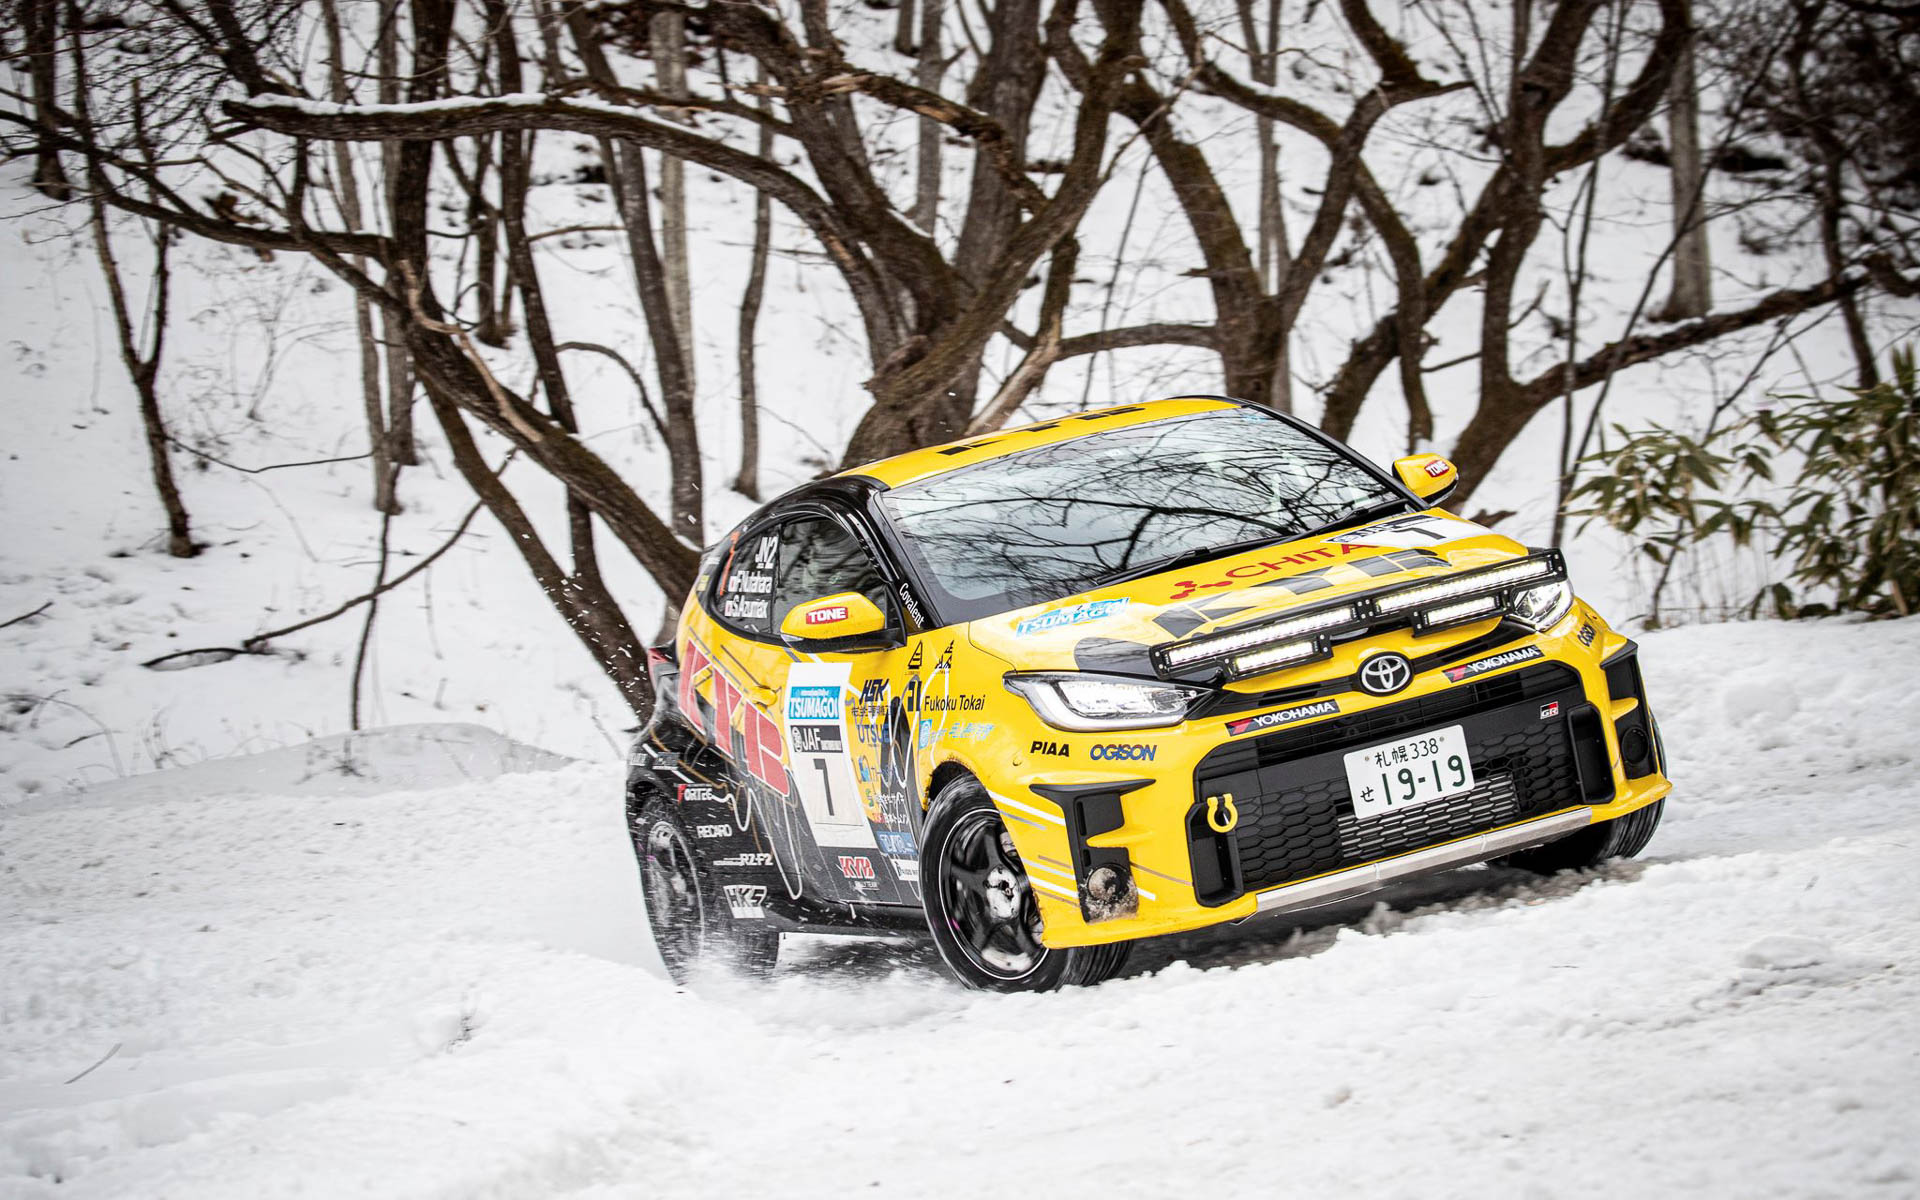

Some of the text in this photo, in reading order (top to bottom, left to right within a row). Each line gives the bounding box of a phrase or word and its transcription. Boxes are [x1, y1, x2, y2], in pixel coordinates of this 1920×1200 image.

[1225, 543, 1380, 578] CHITA
[808, 607, 847, 623] TONE
[899, 582, 924, 628] Covalent
[1467, 646, 1541, 673] YOKOHAMA
[790, 697, 839, 718] TSUMAGOI
[924, 694, 986, 712] Fukoku Tokai
[1253, 701, 1336, 727] YOKOHAMA
[803, 728, 821, 751] JAF
[1030, 741, 1070, 757] PIAA
[1089, 744, 1157, 761] OGISON
[1374, 738, 1439, 768] 札幌 338
[813, 758, 834, 816] 7
[1360, 755, 1466, 805] せ 19-19
[725, 887, 765, 909] HKS
